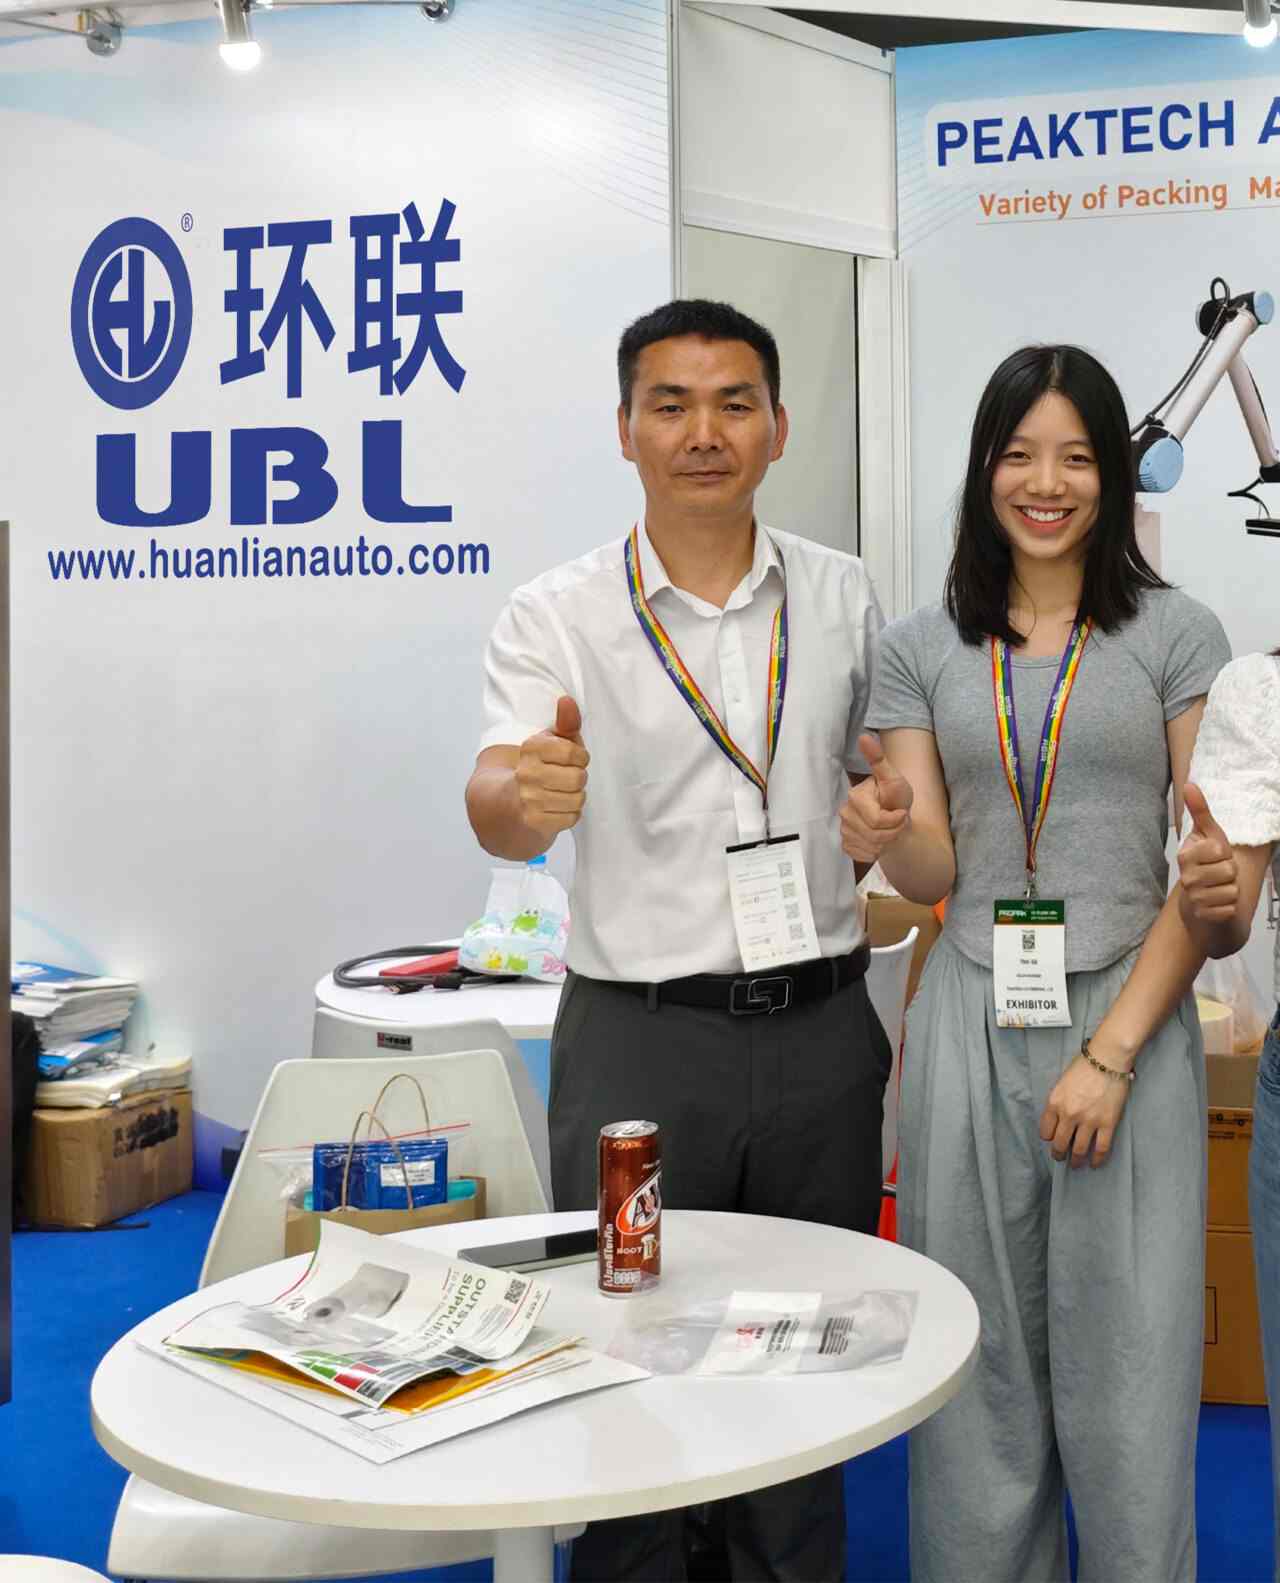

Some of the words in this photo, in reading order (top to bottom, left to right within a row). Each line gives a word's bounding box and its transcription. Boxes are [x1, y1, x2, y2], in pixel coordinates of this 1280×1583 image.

[937, 101, 1234, 167] PEAKTECH
[979, 190, 1072, 219] Variety
[1081, 186, 1107, 209] of
[1117, 180, 1228, 210] Packing
[220, 198, 466, 398] 环联
[96, 420, 453, 528] UBL
[48, 536, 490, 580] www.huanlianauto.com
[1006, 999, 1057, 1010] EXHIBITOR
